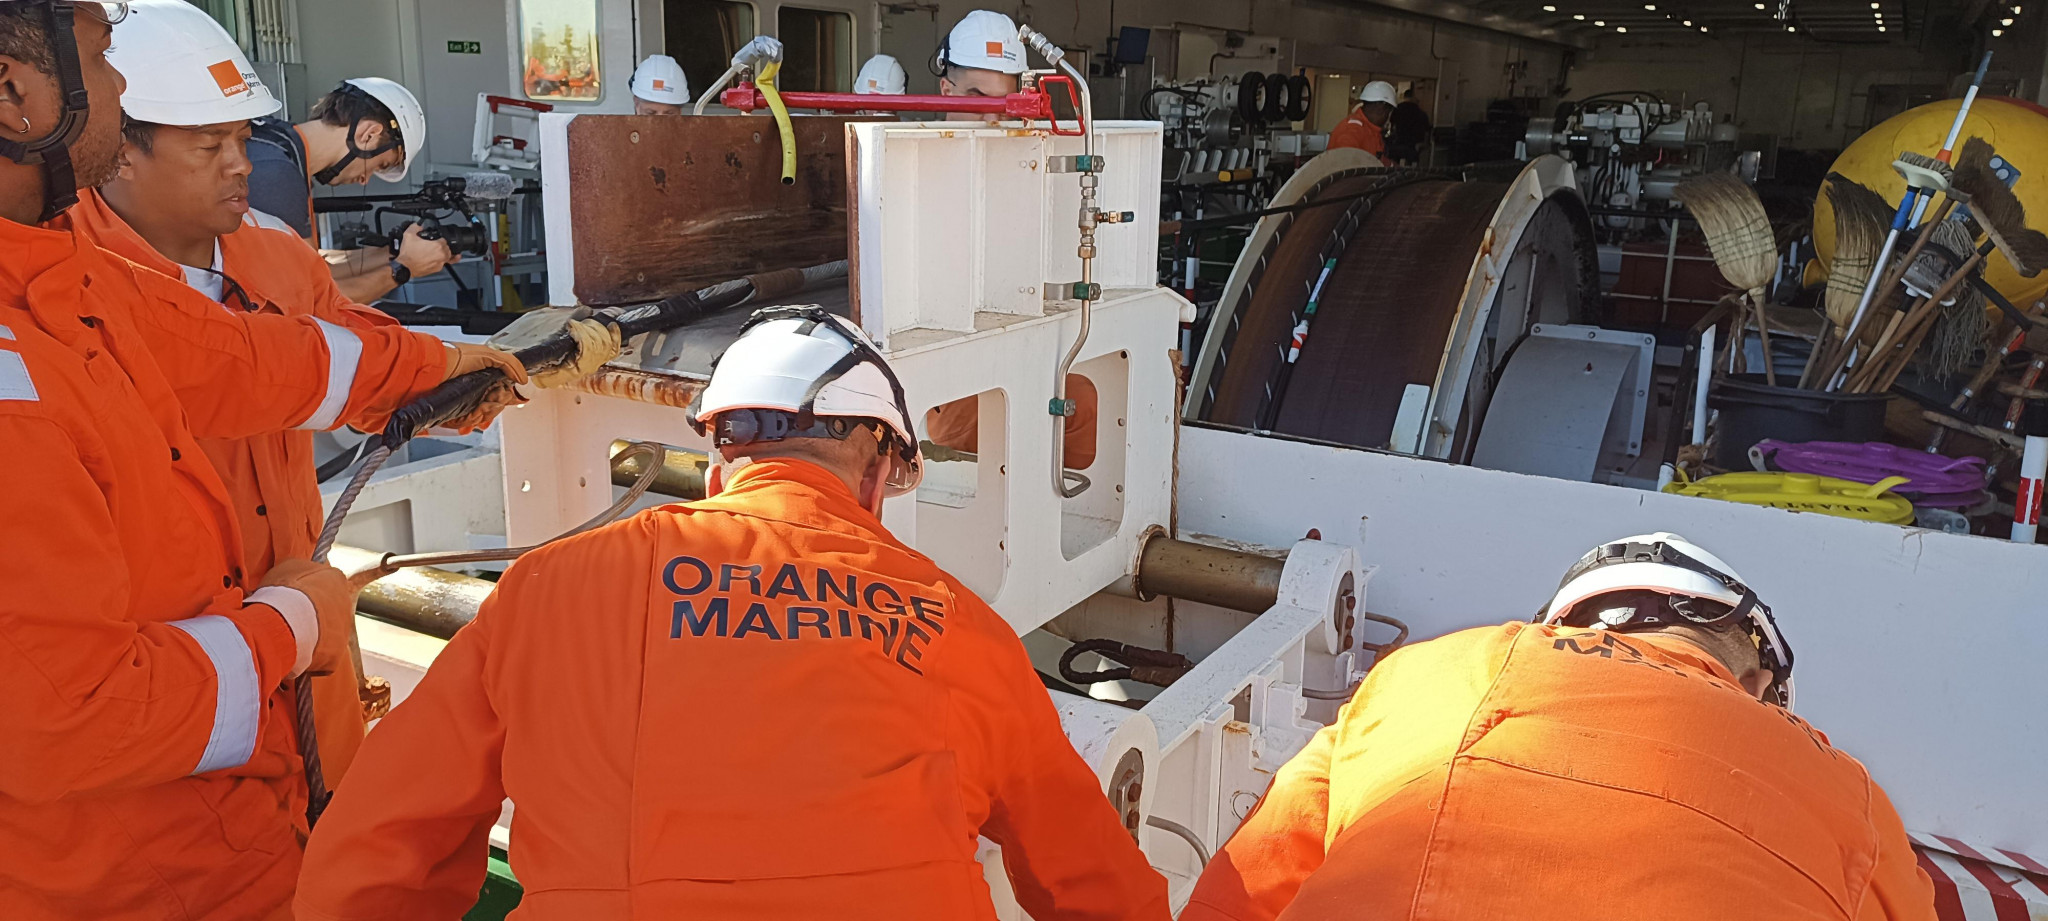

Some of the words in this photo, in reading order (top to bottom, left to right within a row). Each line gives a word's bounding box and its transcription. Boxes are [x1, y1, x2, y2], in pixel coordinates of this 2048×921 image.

[223, 82, 246, 94] orange
[662, 556, 945, 637] ORANGE
[669, 597, 932, 677] MARINE
